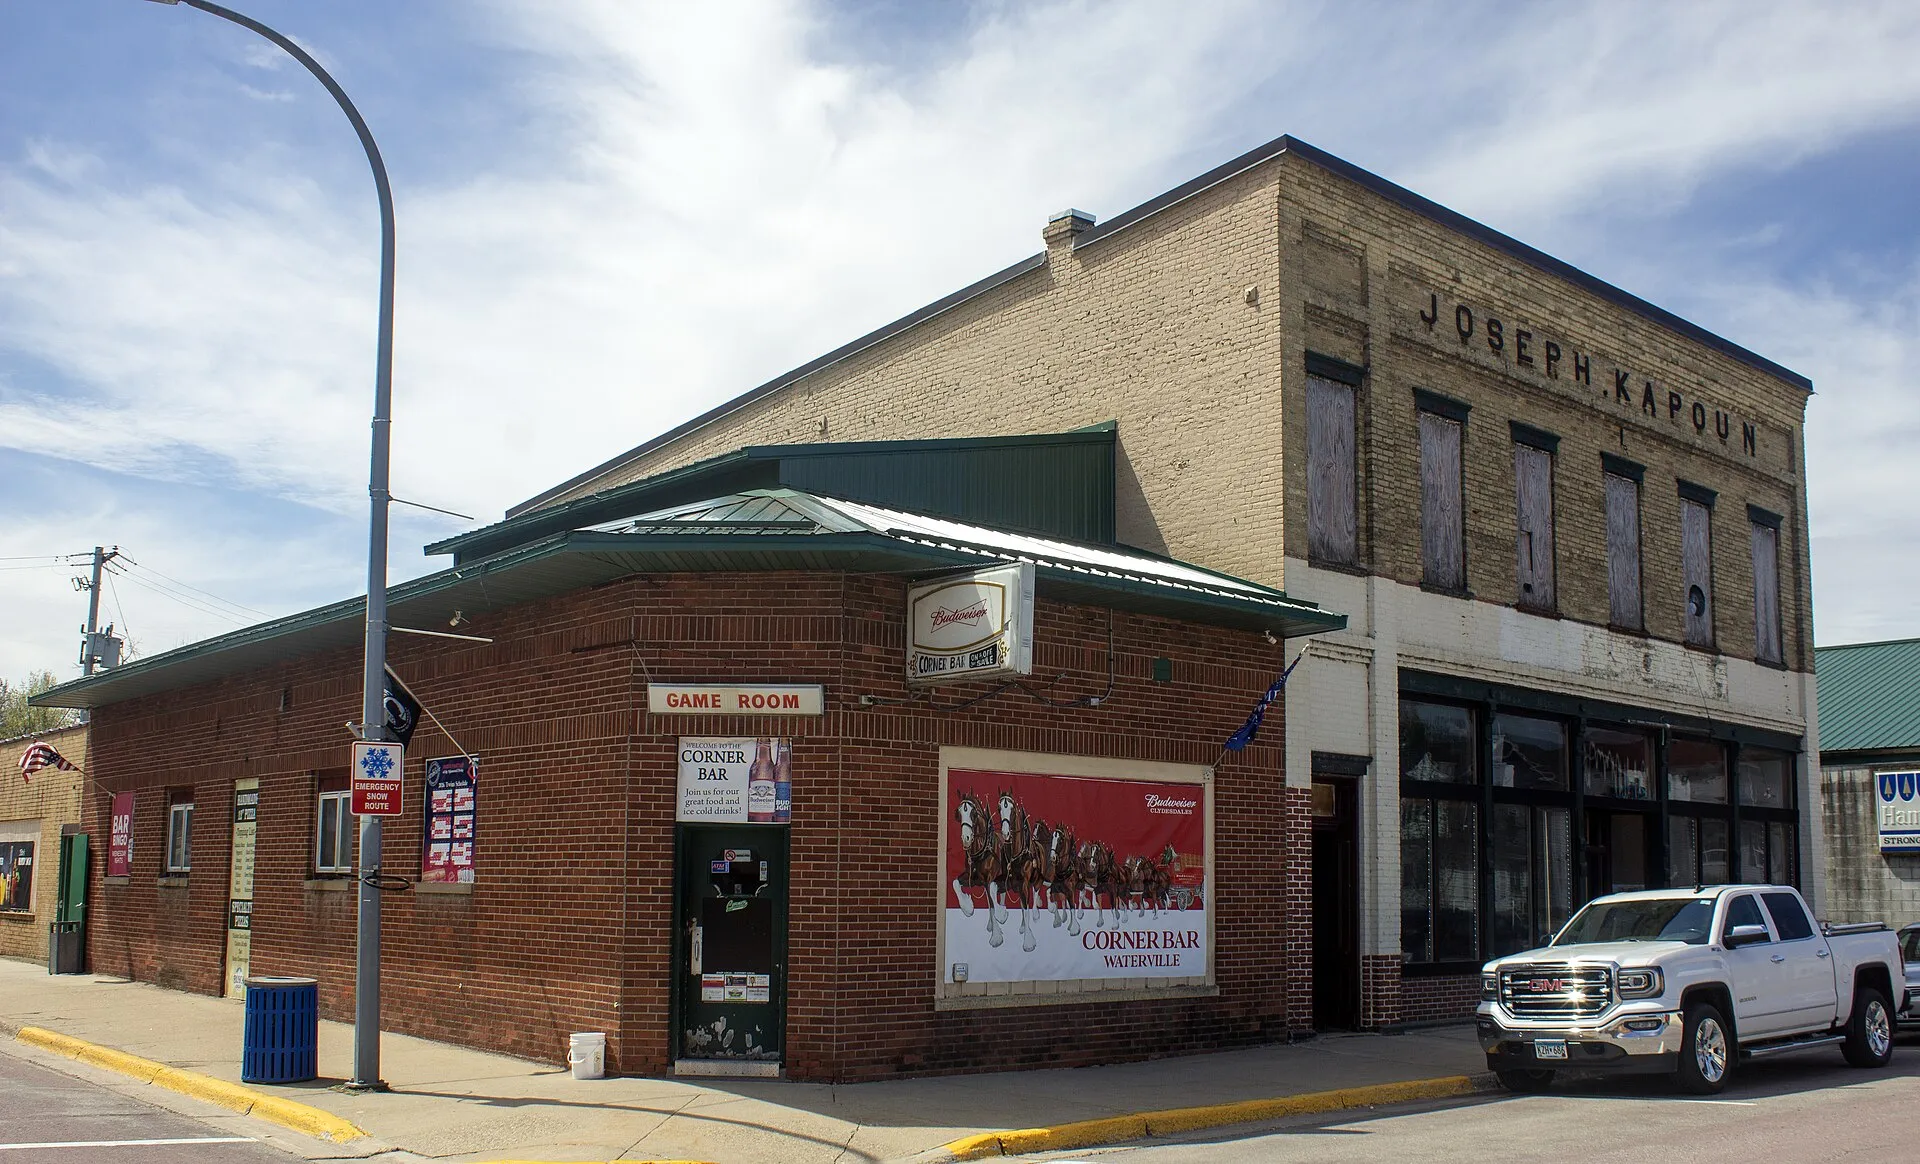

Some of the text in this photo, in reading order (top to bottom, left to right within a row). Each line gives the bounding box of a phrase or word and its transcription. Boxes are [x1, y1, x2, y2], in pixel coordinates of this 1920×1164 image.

[1615, 368, 1757, 458] KAPOUN
[931, 607, 987, 626] Budweiser
[970, 653, 979, 662] ON
[982, 647, 993, 658] OFF
[976, 655, 994, 666] SALE
[919, 655, 966, 674] CORNER BAR
[667, 693, 800, 709] GAME ROOM
[681, 750, 747, 764] CORNER
[697, 767, 729, 781] BAR
[355, 782, 400, 791] EMERGENCY
[684, 788, 701, 798] Join
[713, 787, 726, 796] for
[366, 792, 388, 800] SNOW
[685, 797, 740, 808] great food and
[1144, 793, 1197, 808] Budweiser
[364, 802, 390, 810] ROUTE
[683, 806, 742, 815] ice cold drinks!
[1150, 807, 1193, 815] CLYDESDALES
[112, 814, 130, 834] BAR
[112, 834, 128, 846] BINGO
[1082, 930, 1200, 950] CORNER BAR
[1104, 954, 1180, 968] WATERVILLE
[1528, 978, 1574, 992] GMC
